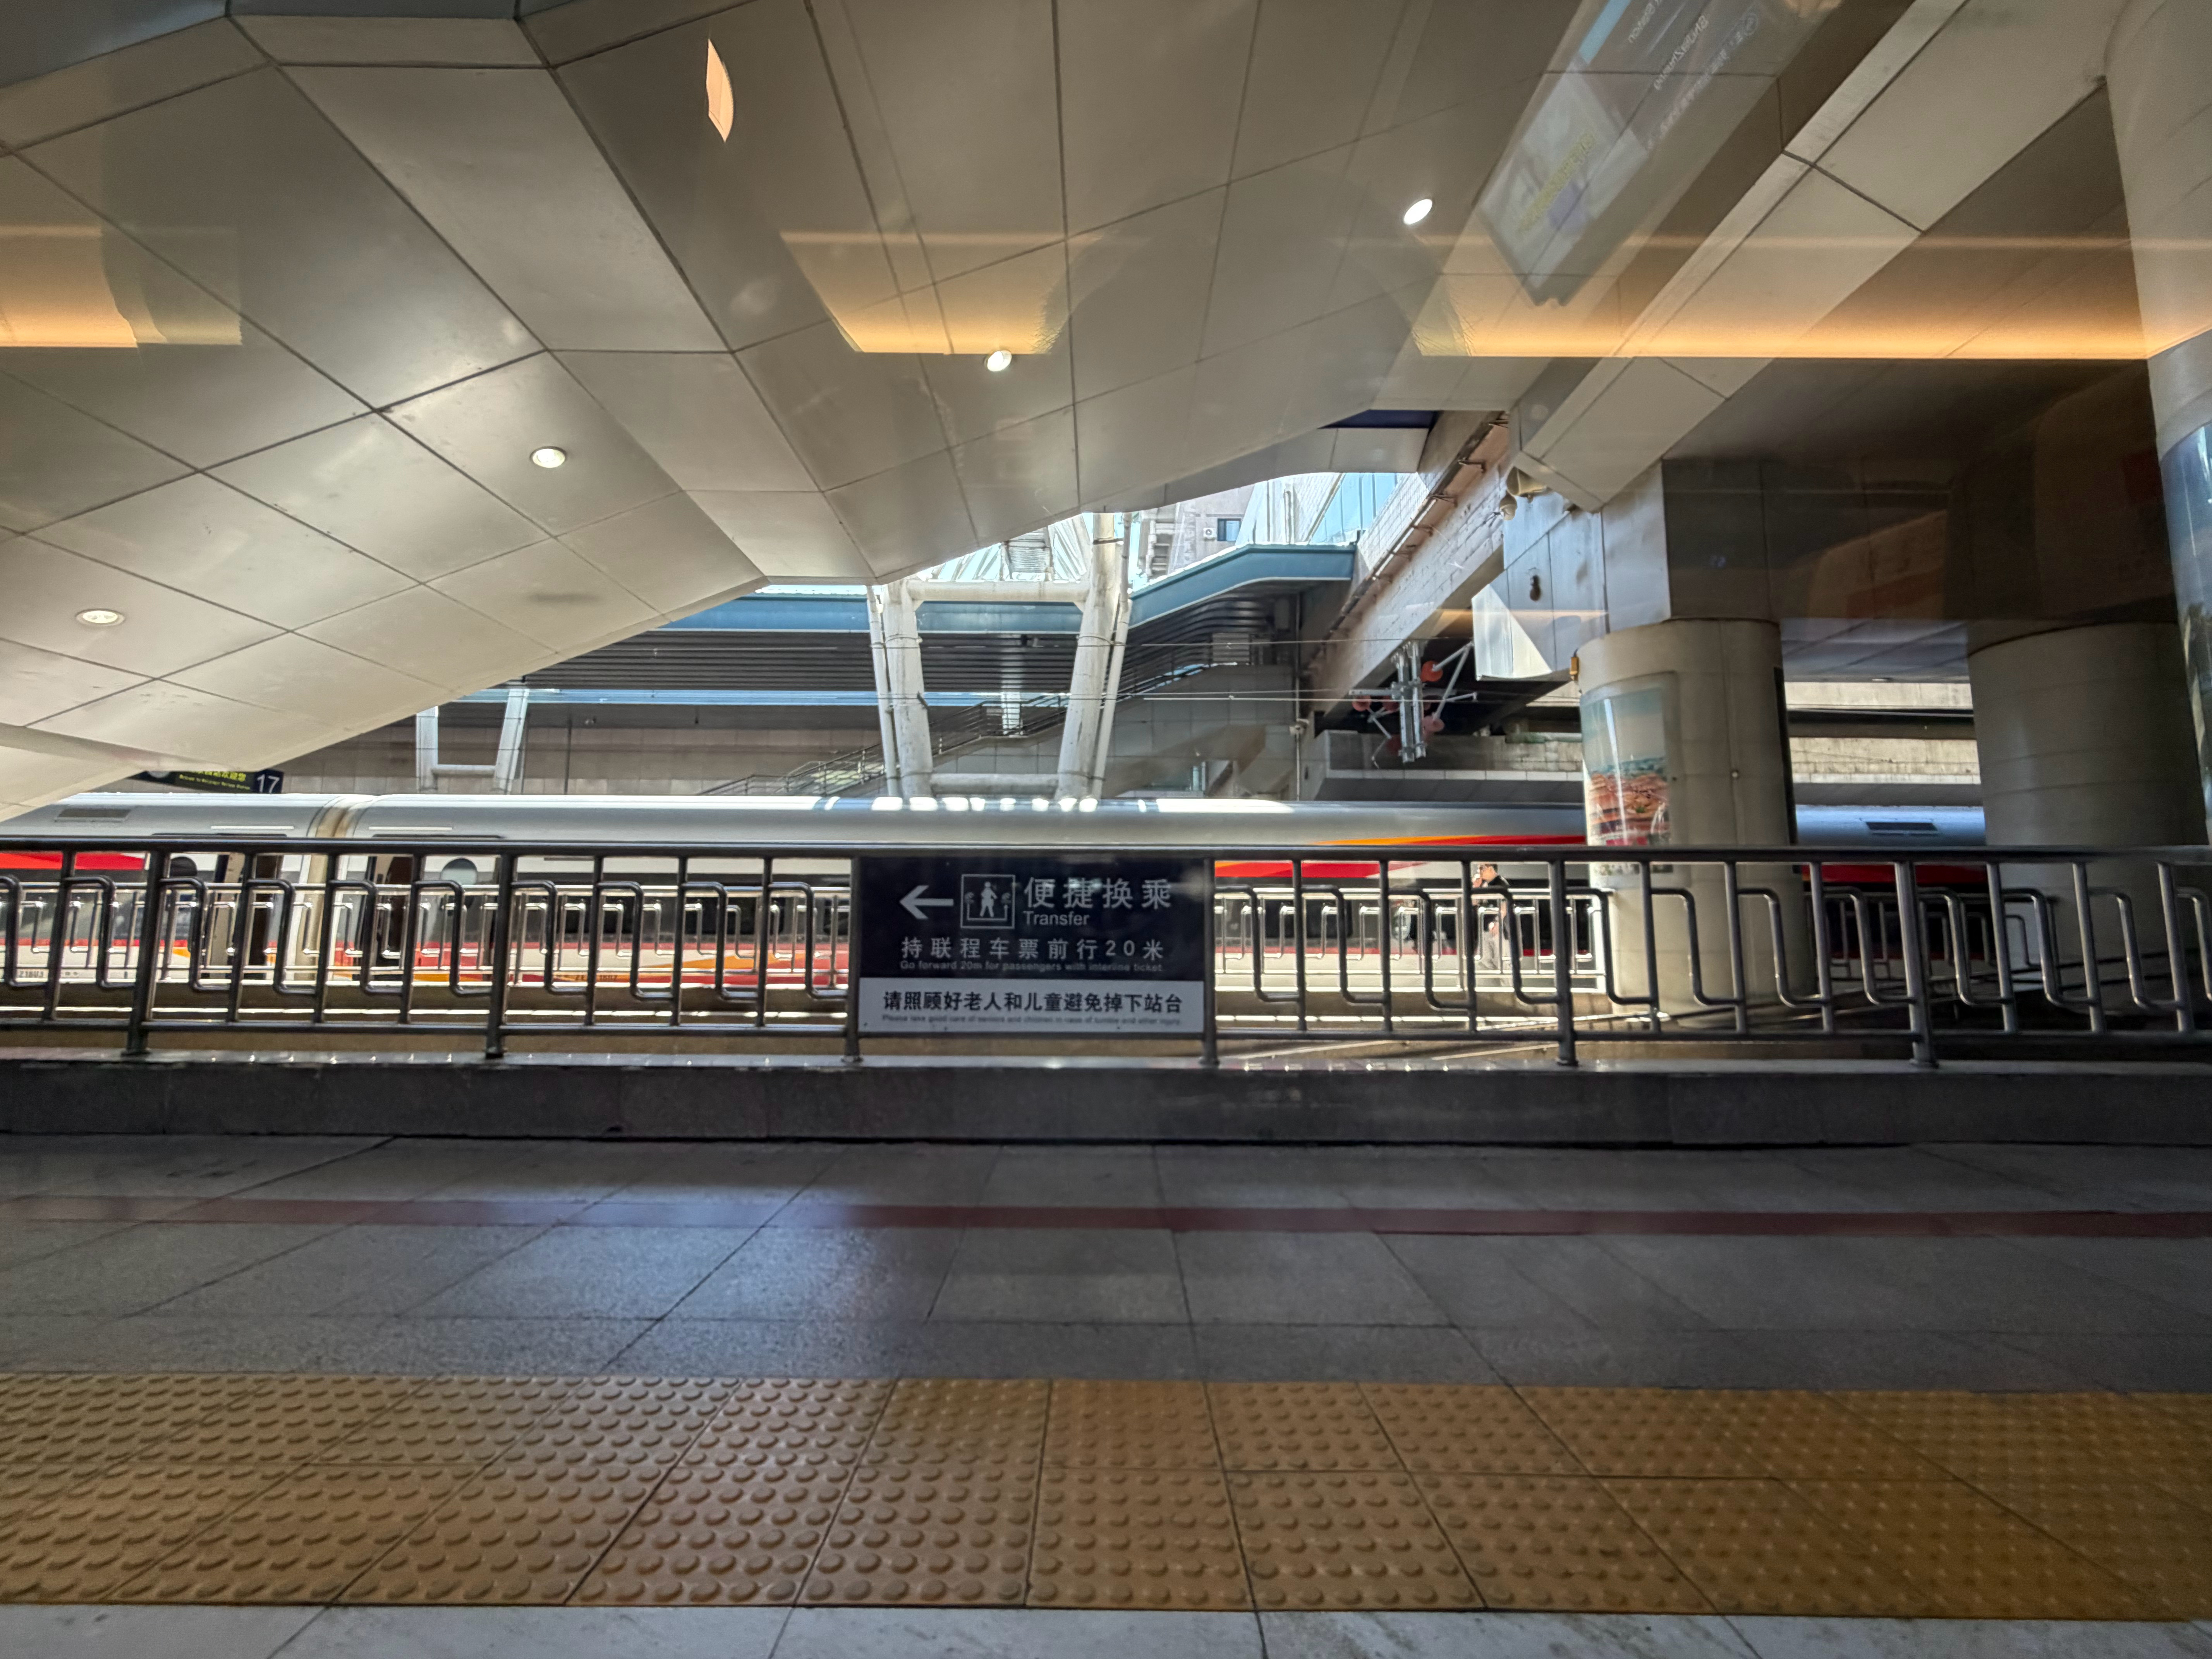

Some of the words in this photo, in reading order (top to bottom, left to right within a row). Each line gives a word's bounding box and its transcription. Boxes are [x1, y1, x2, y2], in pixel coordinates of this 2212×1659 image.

[257, 774, 280, 793] 17
[1024, 877, 1172, 909] 便捷换乘
[1023, 910, 1090, 926] Transfer
[901, 936, 1164, 961] 持联程车票前行20米
[883, 990, 1183, 1014] 请照顾好老人和儿童避免掉下站台
